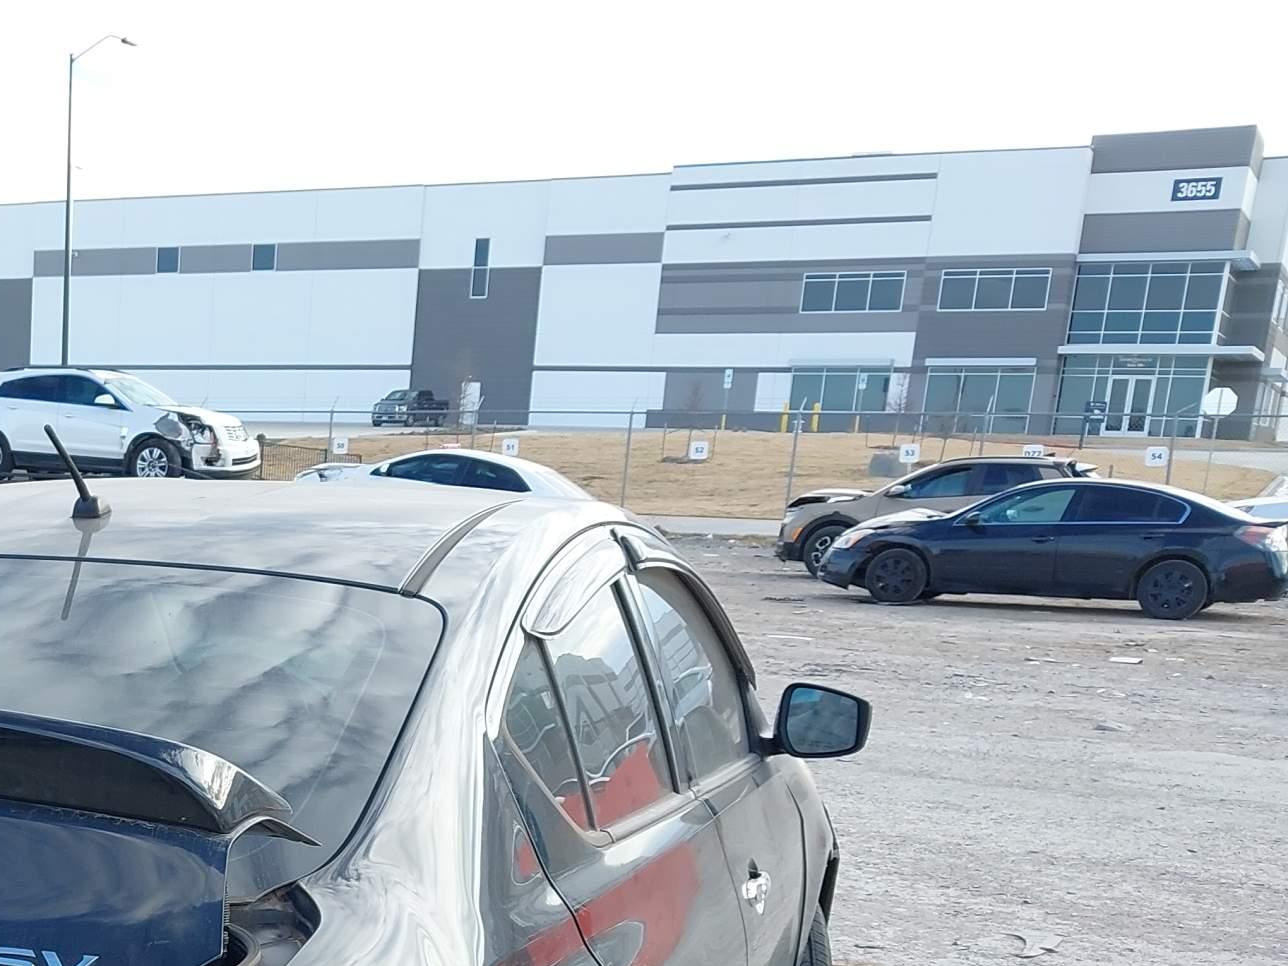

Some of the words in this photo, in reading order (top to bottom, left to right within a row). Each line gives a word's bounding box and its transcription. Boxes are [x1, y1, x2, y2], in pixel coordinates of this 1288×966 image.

[1176, 181, 1217, 198] 3655
[904, 449, 916, 457] 53
[1151, 452, 1162, 460] 54
